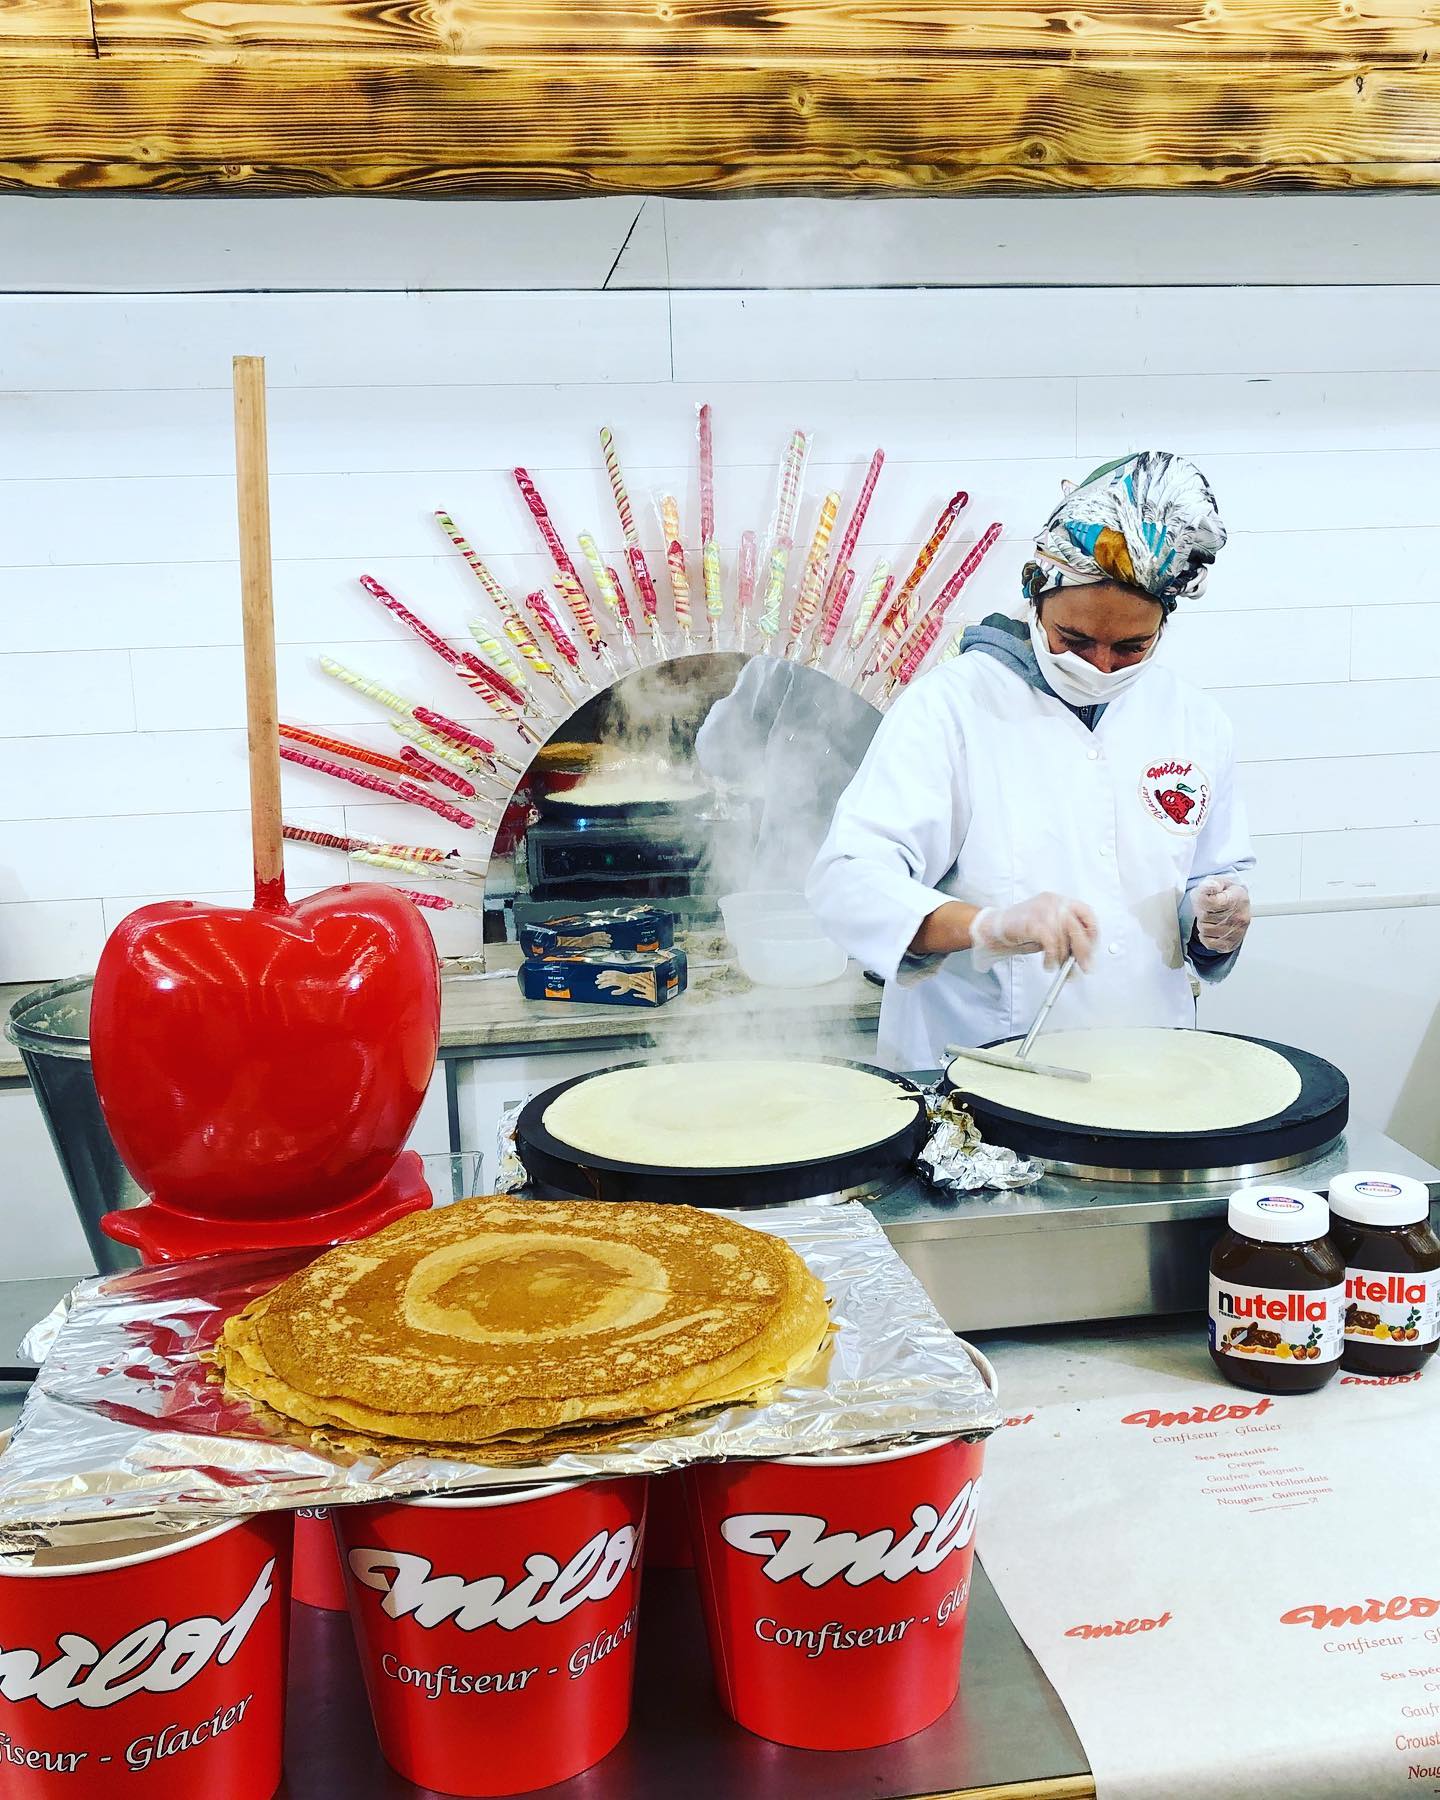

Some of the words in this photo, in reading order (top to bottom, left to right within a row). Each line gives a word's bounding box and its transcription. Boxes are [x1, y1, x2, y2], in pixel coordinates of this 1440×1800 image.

[1146, 761, 1192, 780] milot
[1218, 1290, 1327, 1322] nutella
[1121, 1398, 1274, 1428] milot
[1152, 1429, 1219, 1446] Confiseur
[1235, 1422, 1282, 1437] Glacier
[1200, 1482, 1268, 1496] Croustillons
[754, 1617, 915, 1658] Confiseur
[1064, 1612, 1173, 1640] milot
[1323, 1635, 1404, 1656] Confiseur
[381, 1653, 539, 1700] Confiseur
[1380, 1671, 1407, 1681] Ses
[126, 1694, 253, 1772] Glacier
